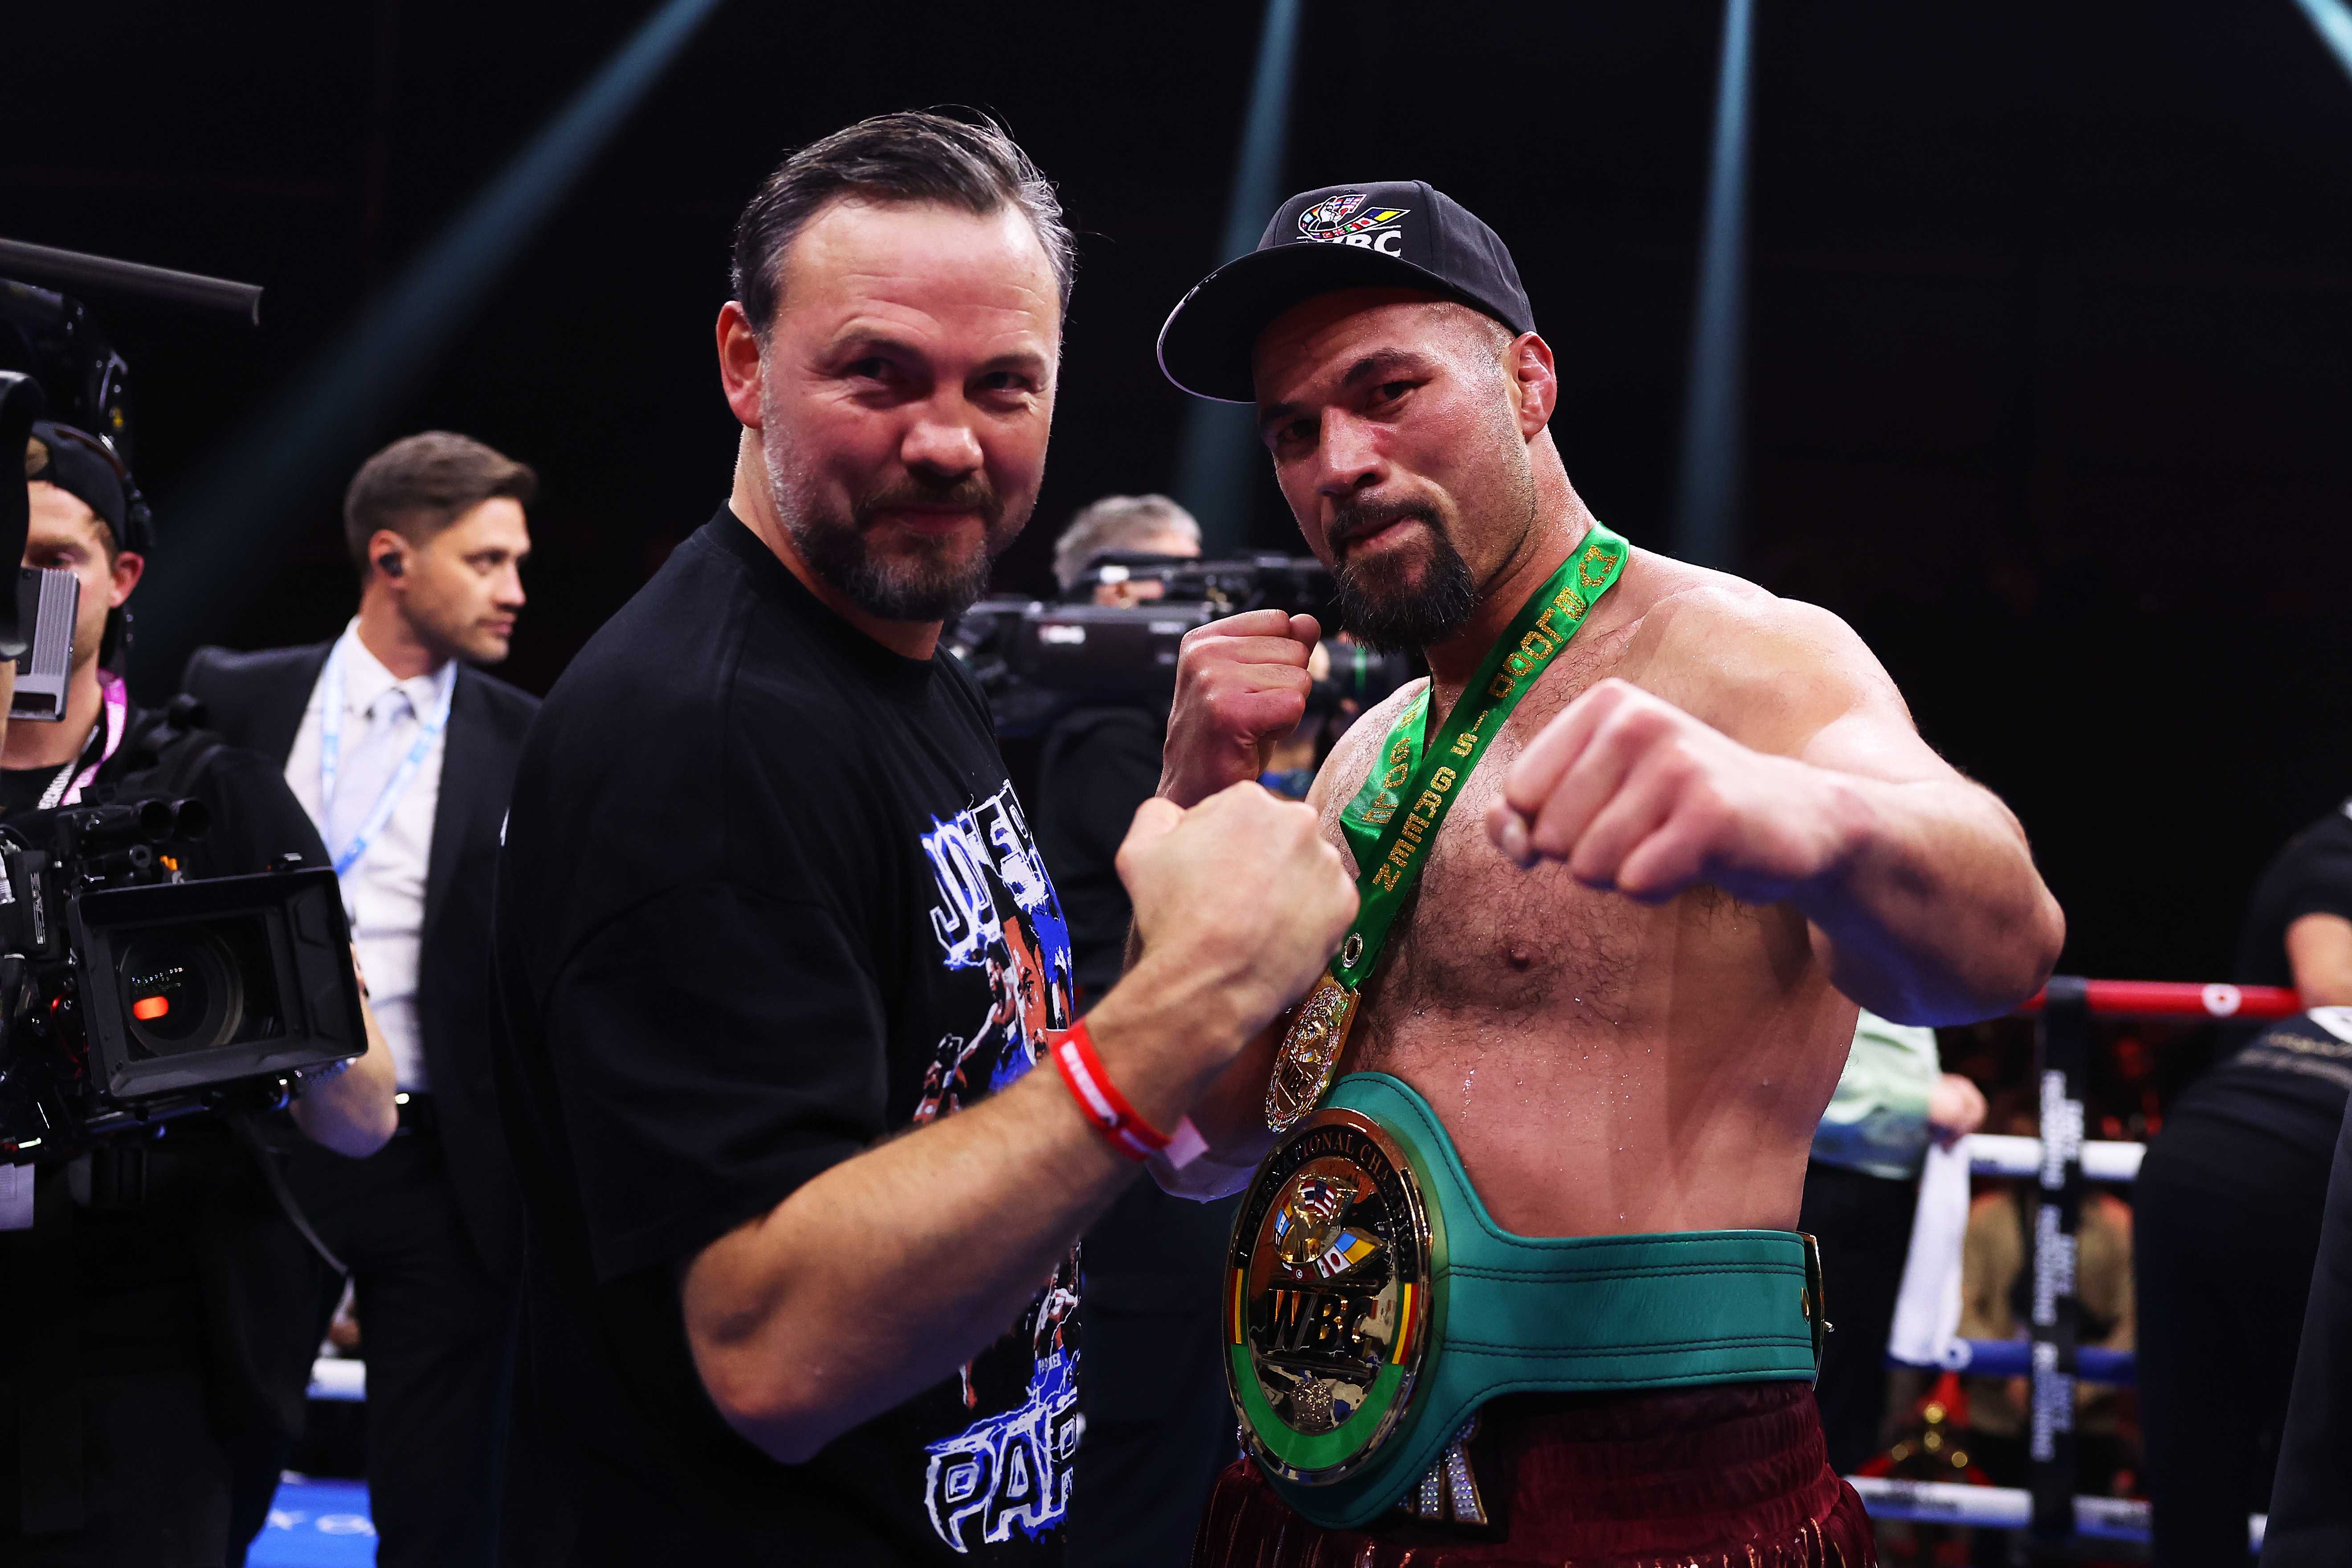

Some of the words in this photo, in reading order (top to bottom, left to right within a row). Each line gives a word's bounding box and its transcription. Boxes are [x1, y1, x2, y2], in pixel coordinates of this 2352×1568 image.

[1298, 230, 1402, 257] BC
[1488, 586, 1586, 699] BLOOD
[1450, 710, 1489, 757] IS
[1372, 766, 1457, 892] GREEN
[1266, 1288, 1379, 1358] WBC
